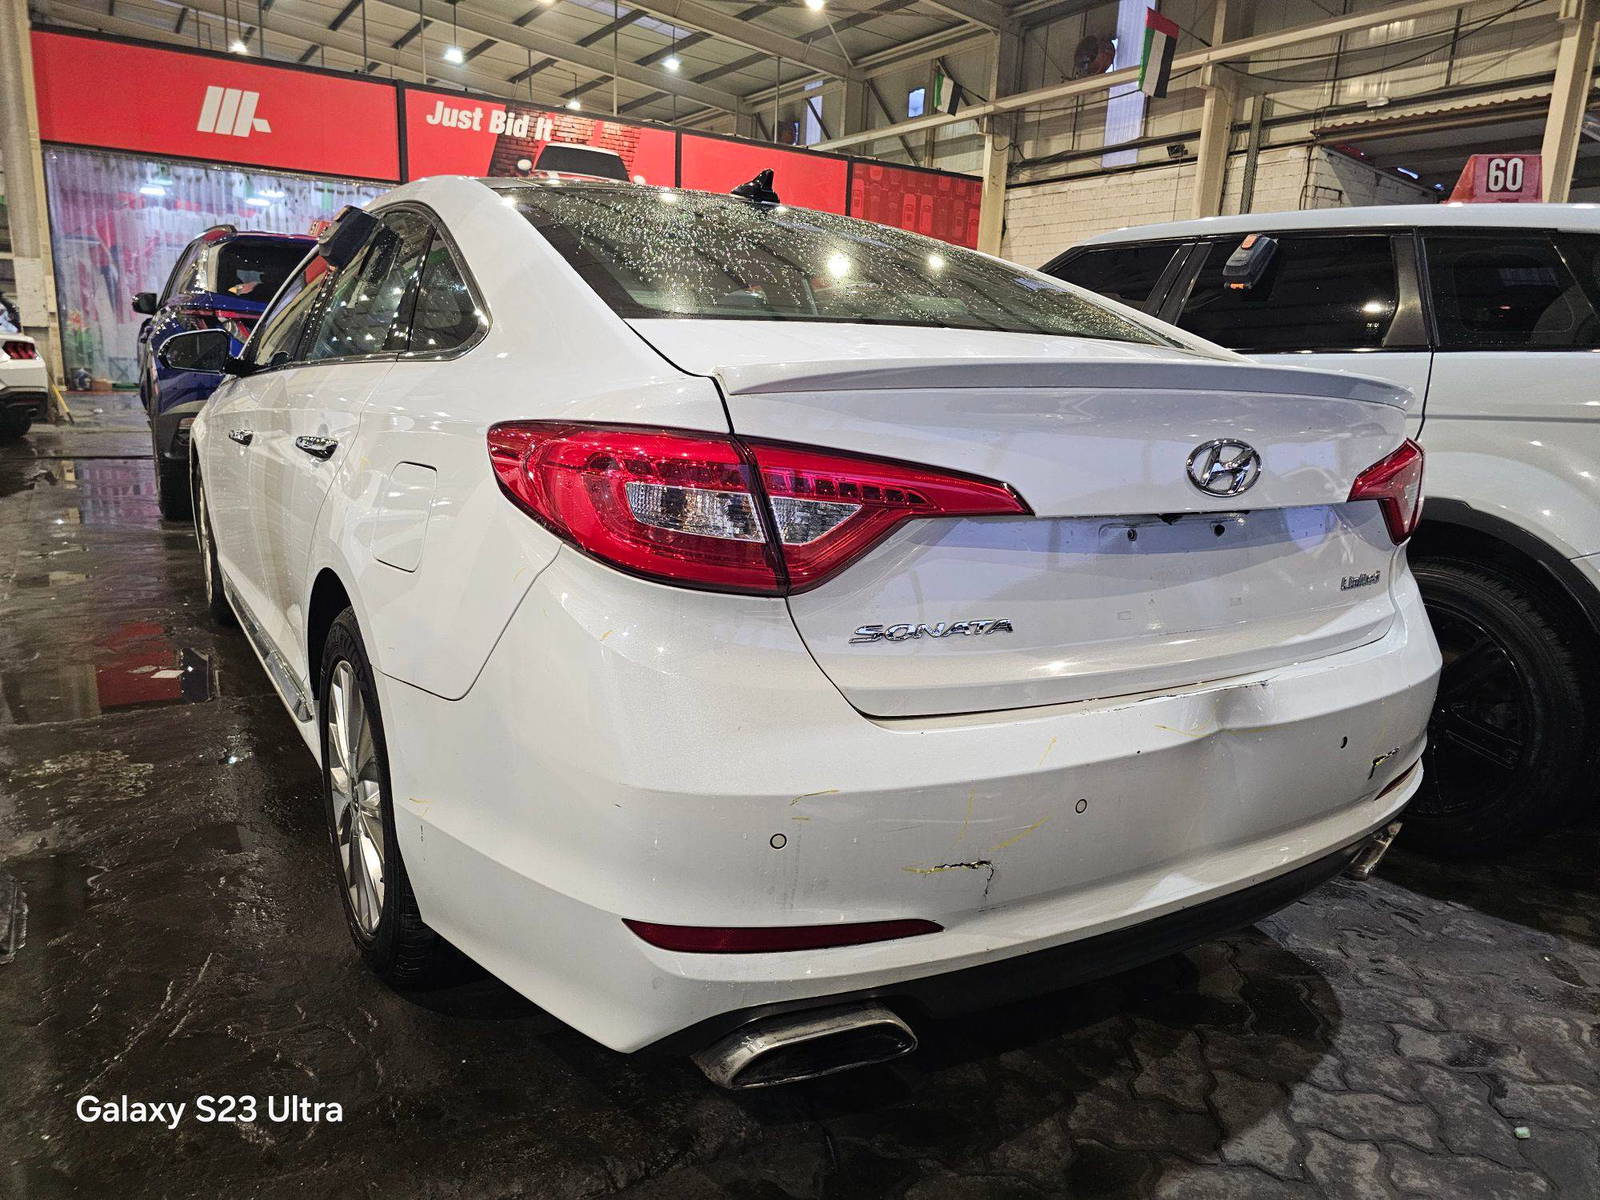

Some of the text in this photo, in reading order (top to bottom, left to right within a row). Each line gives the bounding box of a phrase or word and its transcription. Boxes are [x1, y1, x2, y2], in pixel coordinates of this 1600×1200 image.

[426, 101, 553, 141] Just Bid It
[1488, 158, 1524, 191] 60
[848, 618, 1014, 644] SONATA
